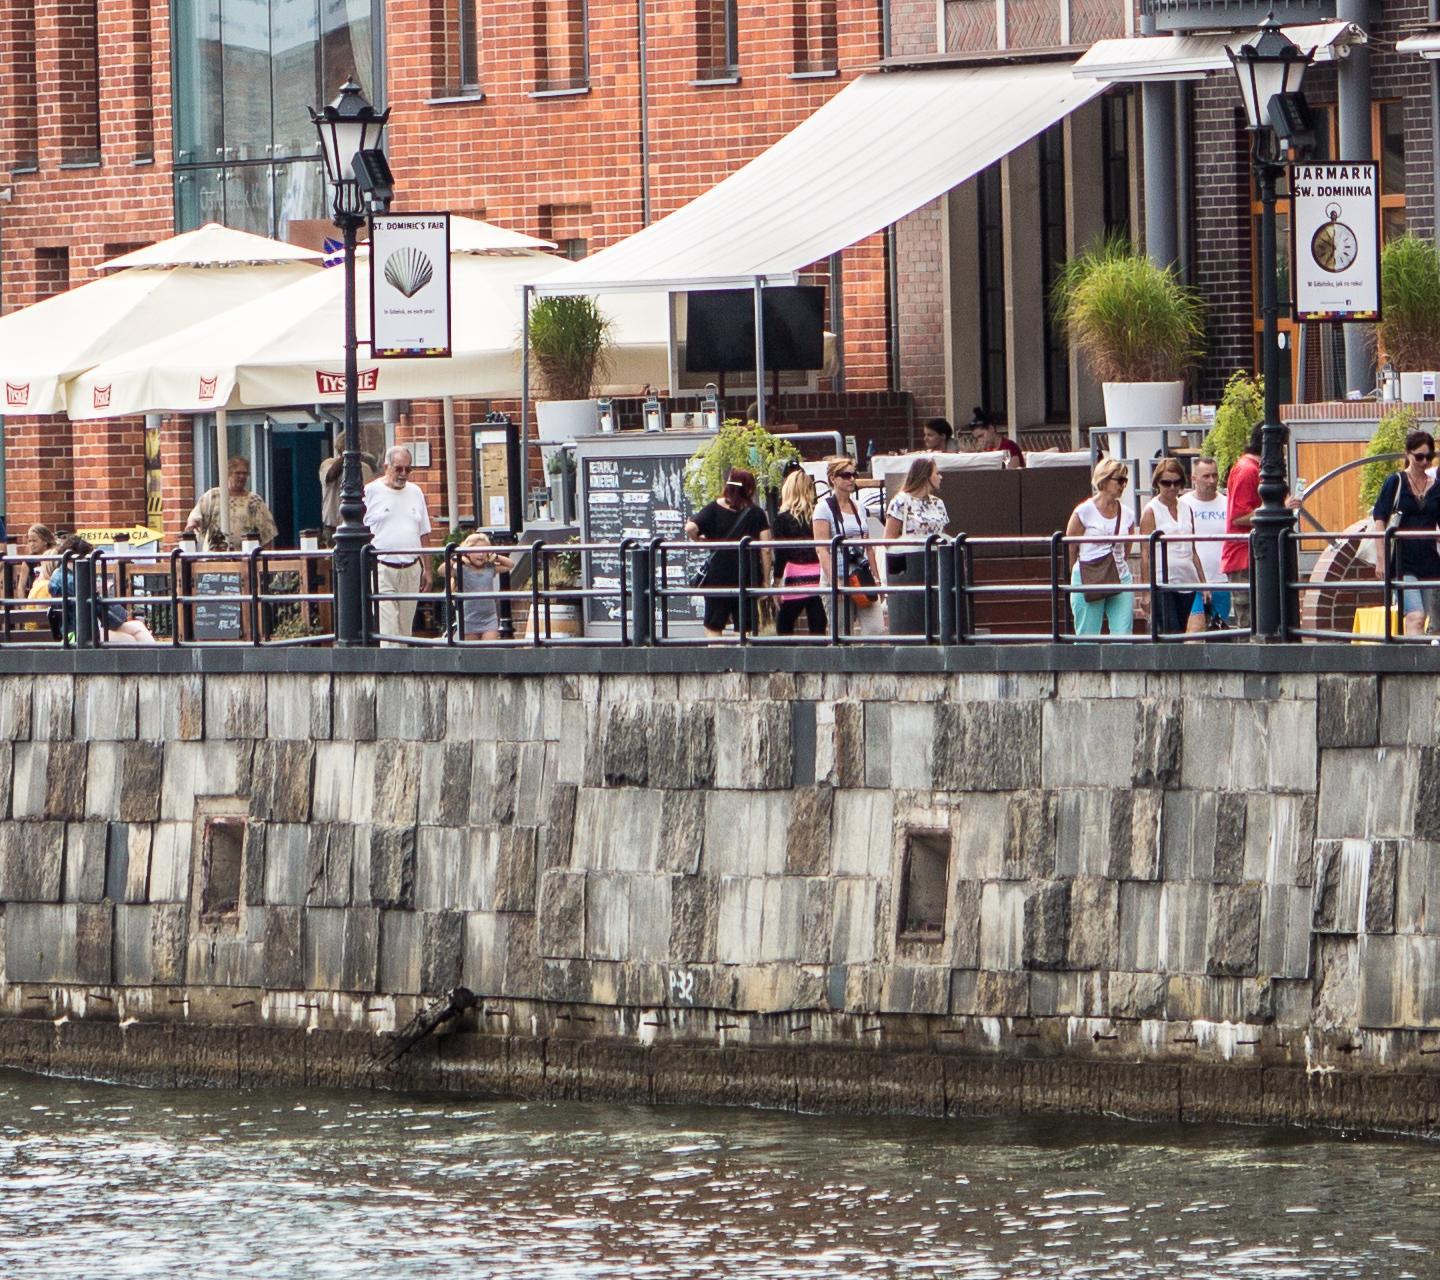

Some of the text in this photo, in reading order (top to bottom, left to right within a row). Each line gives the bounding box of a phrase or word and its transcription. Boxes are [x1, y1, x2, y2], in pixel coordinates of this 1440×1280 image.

[1295, 167, 1373, 180] JARMARK
[1295, 185, 1373, 197] ŚW. DOMINIKA
[386, 222, 425, 230] DOMINIC'S
[427, 222, 445, 230] FAIR
[320, 373, 375, 392] TYSIE
